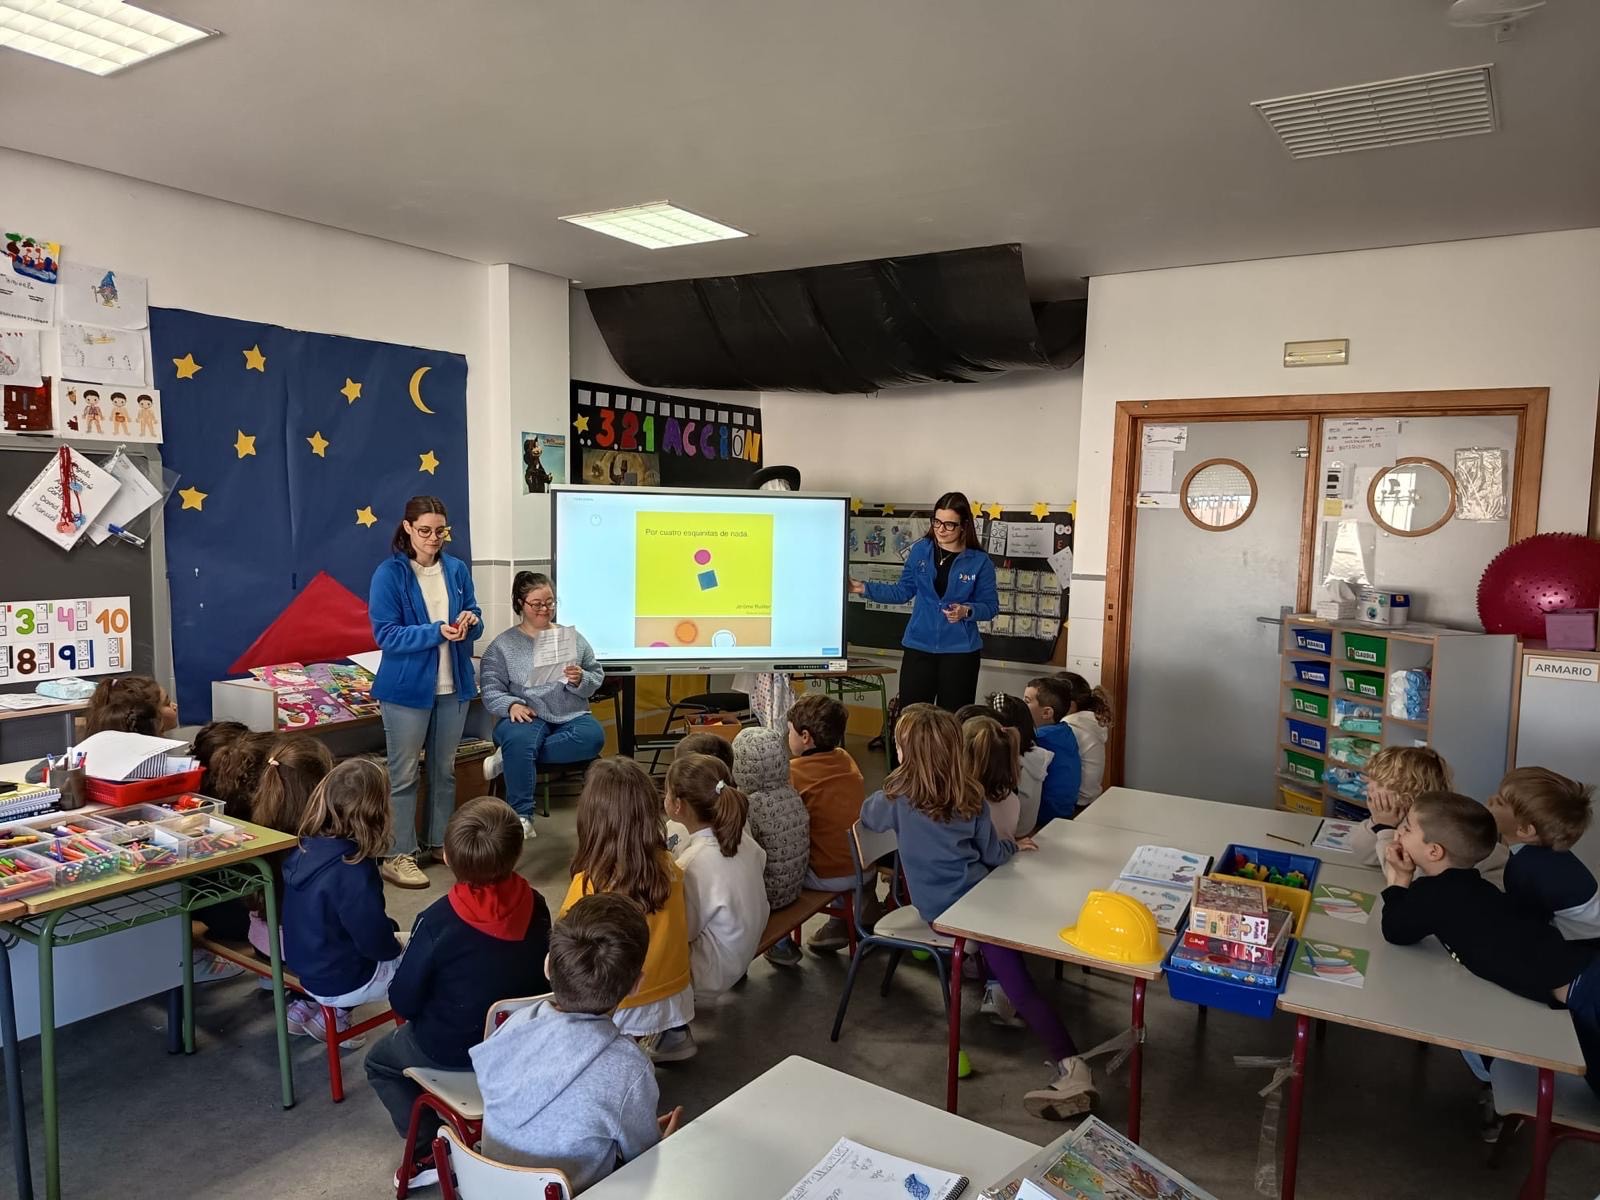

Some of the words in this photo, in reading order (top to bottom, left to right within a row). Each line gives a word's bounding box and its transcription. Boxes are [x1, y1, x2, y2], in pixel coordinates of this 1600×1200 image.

[683, 529, 718, 537] esquinitas
[15, 608, 35, 635] 3
[57, 606, 74, 632] 4
[95, 608, 129, 634] 10
[17, 648, 37, 675] 8
[58, 645, 76, 670] 9
[1535, 663, 1592, 676] ARMARIO
